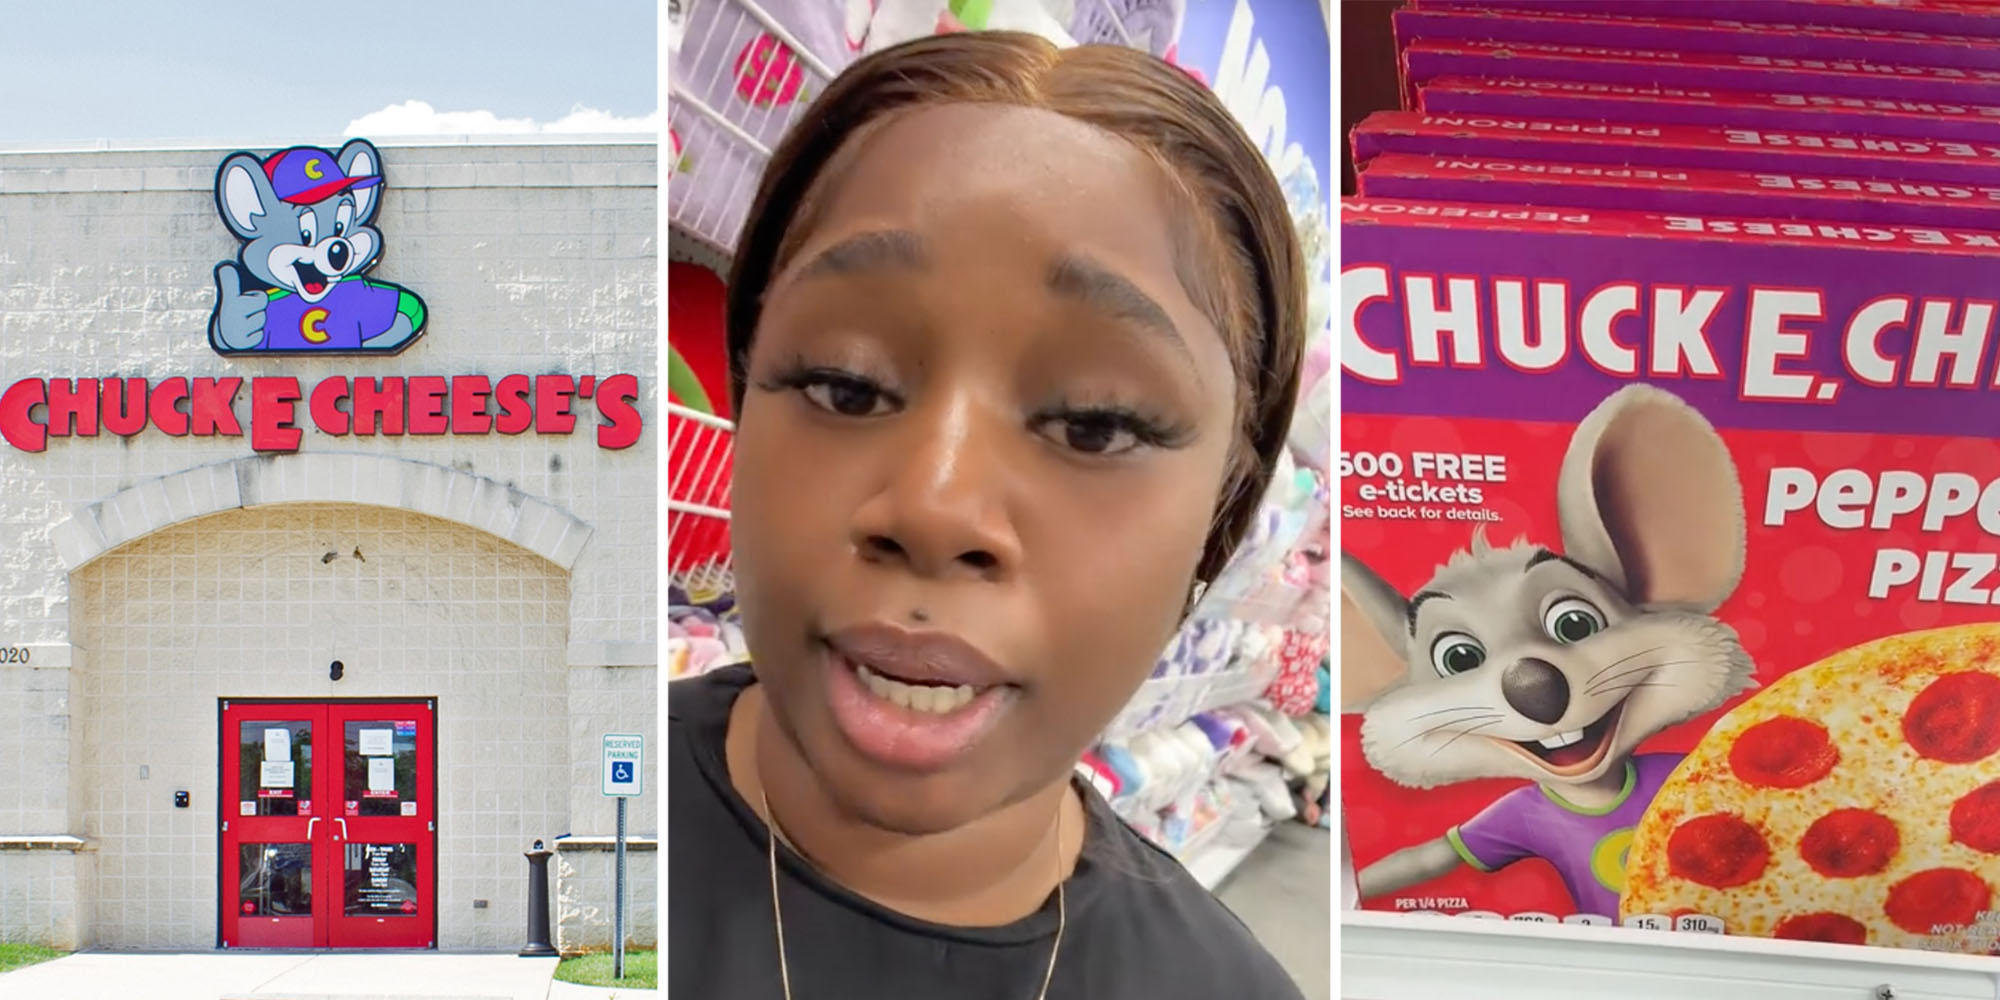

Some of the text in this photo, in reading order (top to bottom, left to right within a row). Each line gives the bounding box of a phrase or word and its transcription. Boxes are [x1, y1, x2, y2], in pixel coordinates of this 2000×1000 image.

[1421, 116, 1661, 137] PEPPERONI
[1724, 130, 1931, 154] CHEESE
[305, 158, 325, 180] C
[1435, 160, 1687, 181] PEPPERONI
[1754, 174, 1974, 199] CHEESE
[1664, 216, 1897, 242] CHEESE
[299, 306, 332, 345] C
[1341, 266, 1728, 382] CHUCK
[1845, 297, 2000, 387] CH
[0, 373, 643, 452] CHUCK E CHEESE'S
[1412, 451, 1507, 482] FREE
[1359, 479, 1484, 504] e-tickets
[1342, 504, 1504, 522] See back for details.
[1868, 548, 2000, 605] PIZ
[604, 740, 641, 749] RESERVED
[607, 750, 639, 759] PARKING
[1395, 896, 1469, 909] PER 1/4 PIZZA
[1930, 924, 1964, 935] NOT
